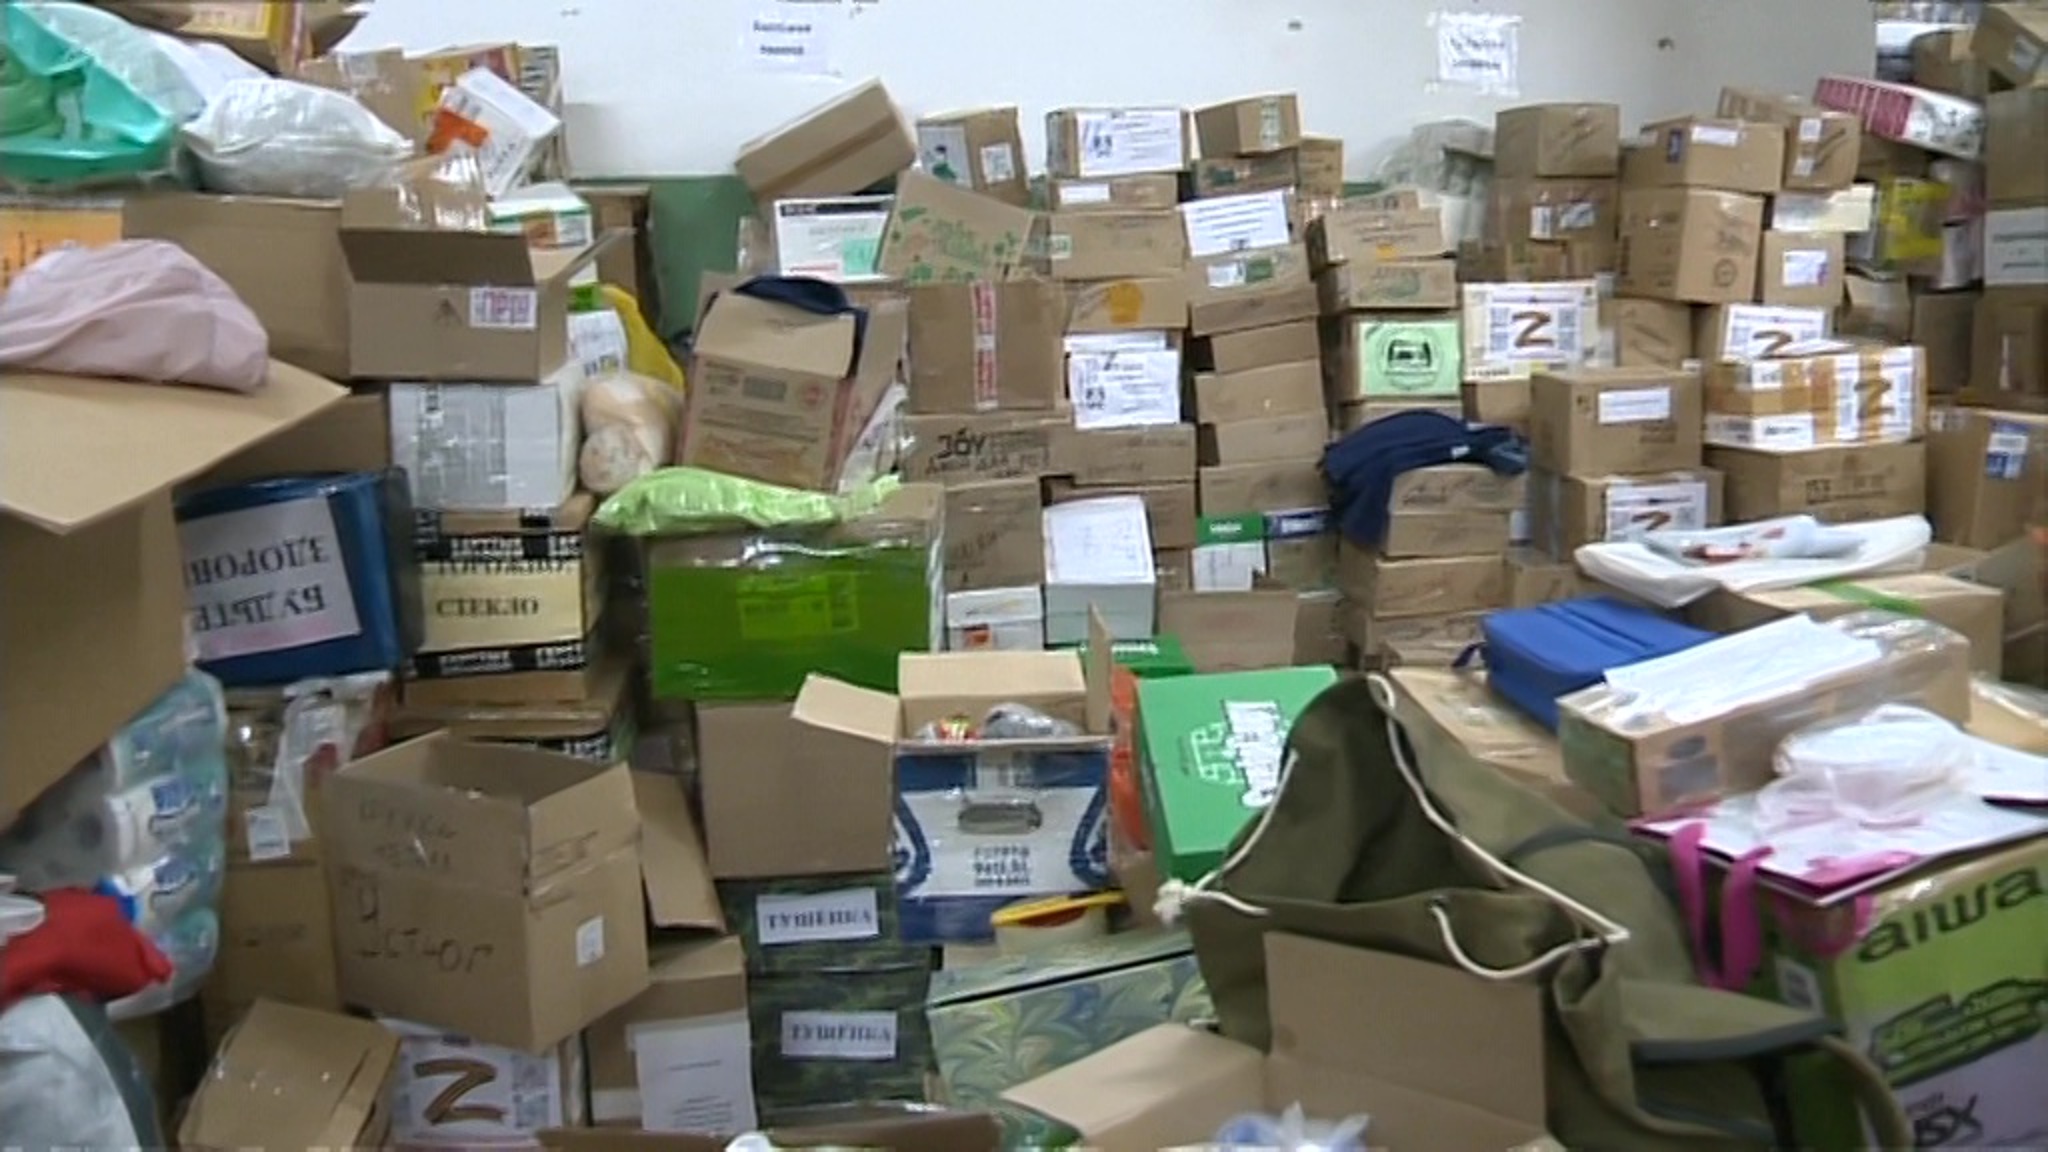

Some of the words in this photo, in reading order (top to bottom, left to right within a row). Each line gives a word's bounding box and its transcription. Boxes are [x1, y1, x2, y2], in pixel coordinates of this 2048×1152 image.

[1511, 311, 1554, 348] Z
[436, 595, 540, 618] СТЕКЛО
[1856, 866, 2045, 963] aiwa
[412, 1057, 508, 1126] Z
